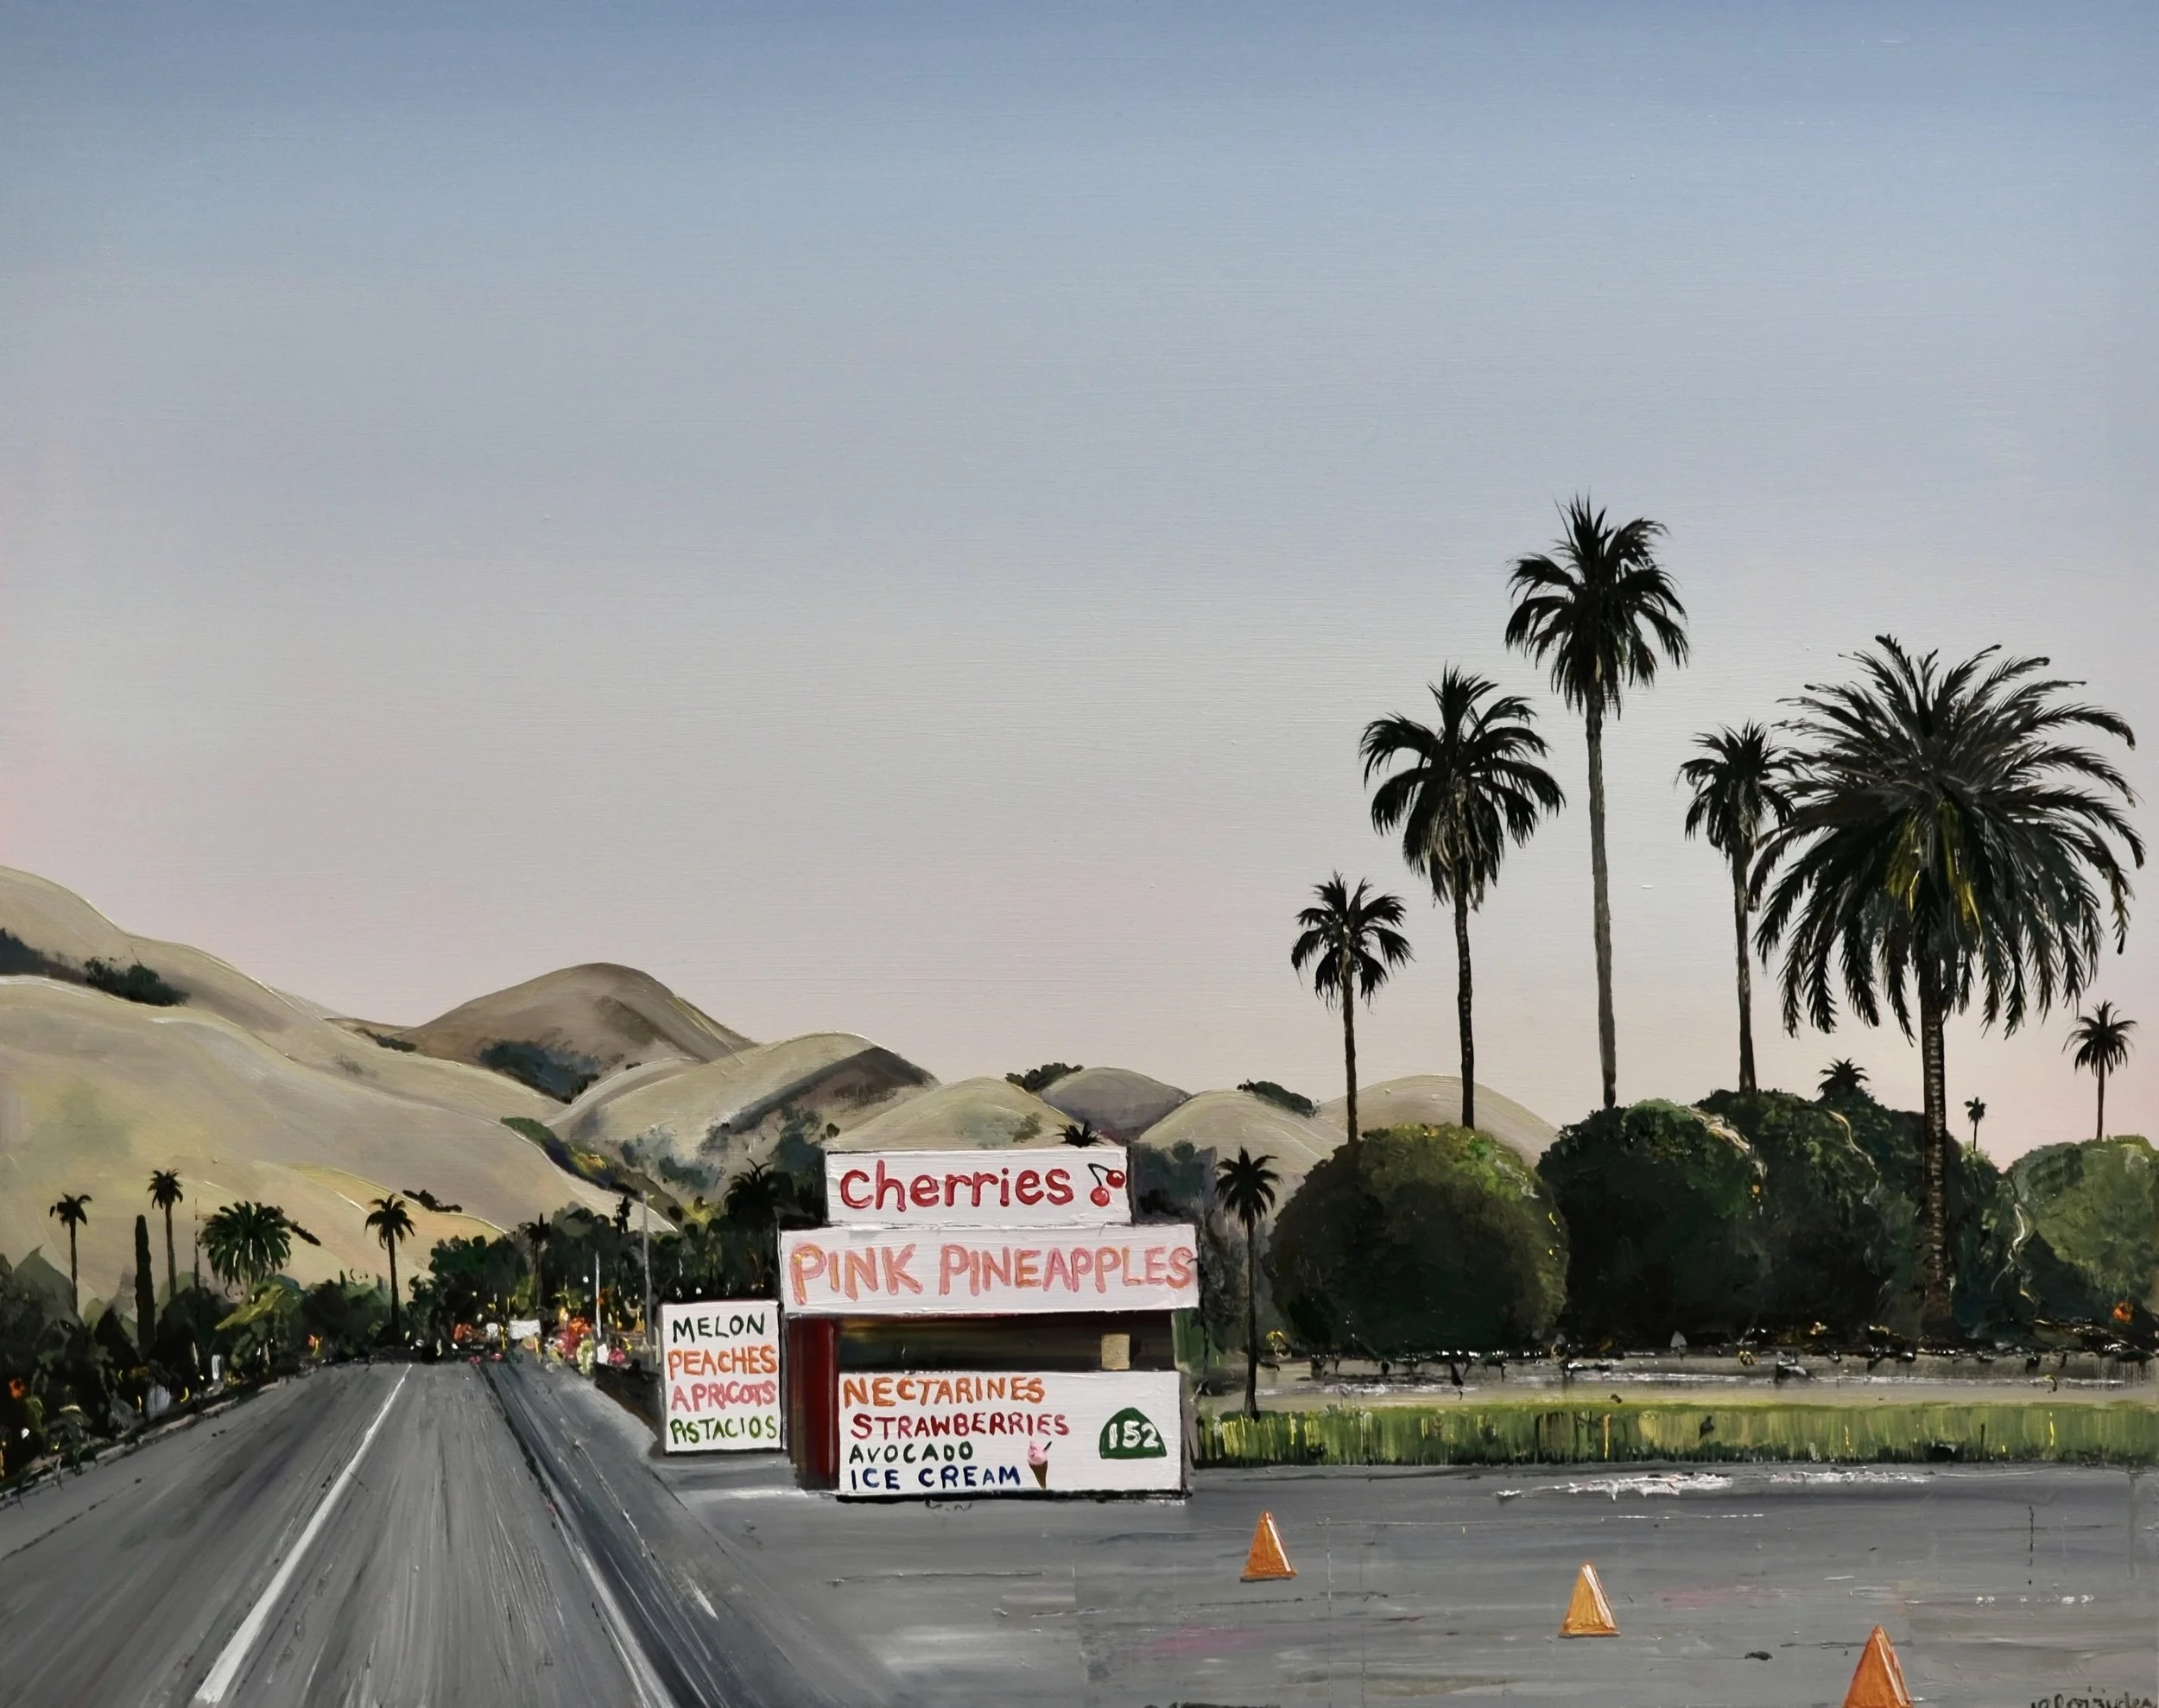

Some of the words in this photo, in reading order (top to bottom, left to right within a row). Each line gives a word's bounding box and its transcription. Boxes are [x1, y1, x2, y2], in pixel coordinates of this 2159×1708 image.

[789, 1242, 923, 1306] PINK
[939, 1243, 1193, 1296] PINEAPPLES
[673, 1312, 765, 1344] MELON
[668, 1344, 778, 1381] PEACHES
[670, 1380, 777, 1413] APRICOTS
[843, 1376, 1046, 1409] NECTARINES
[670, 1415, 777, 1445] PISTACIOS
[851, 1412, 1069, 1440] STRAWBERRIES
[1109, 1420, 1160, 1450] 152
[849, 1440, 973, 1464] AVOCADO
[851, 1468, 900, 1490] ICE
[918, 1464, 1022, 1490] CREAM
